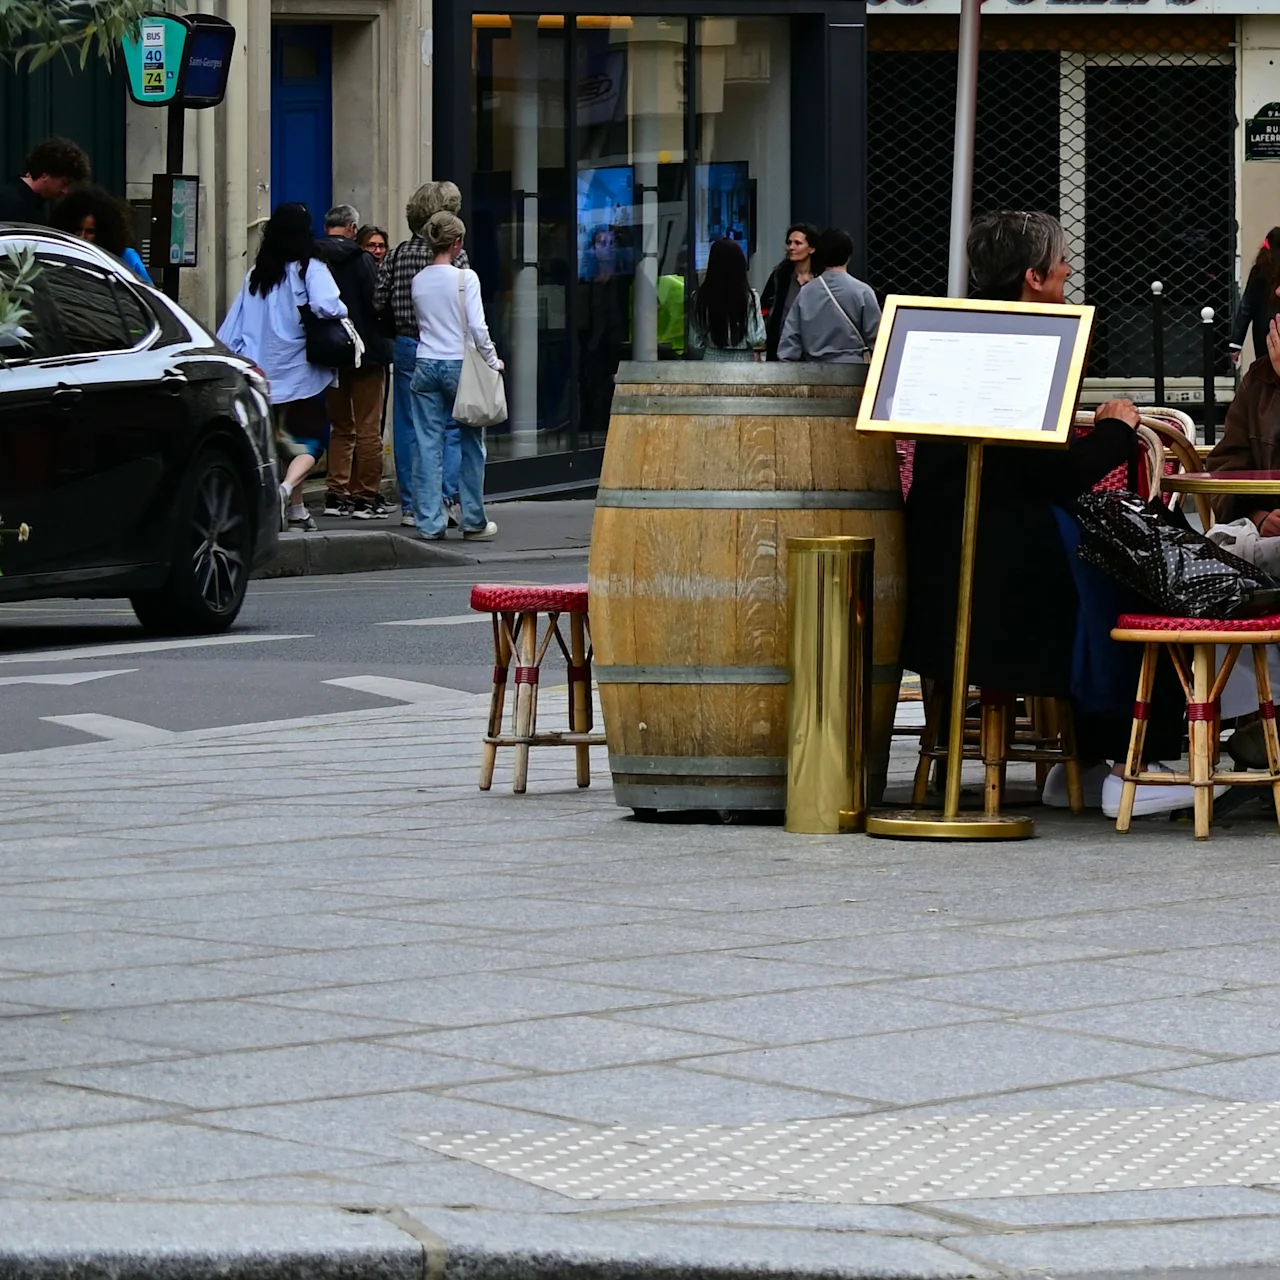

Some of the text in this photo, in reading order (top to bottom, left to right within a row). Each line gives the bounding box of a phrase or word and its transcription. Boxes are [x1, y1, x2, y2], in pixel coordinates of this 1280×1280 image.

[146, 32, 161, 40] BUS
[146, 50, 162, 62] 40
[189, 56, 222, 69] Saint-Georges
[146, 73, 162, 85] 74
